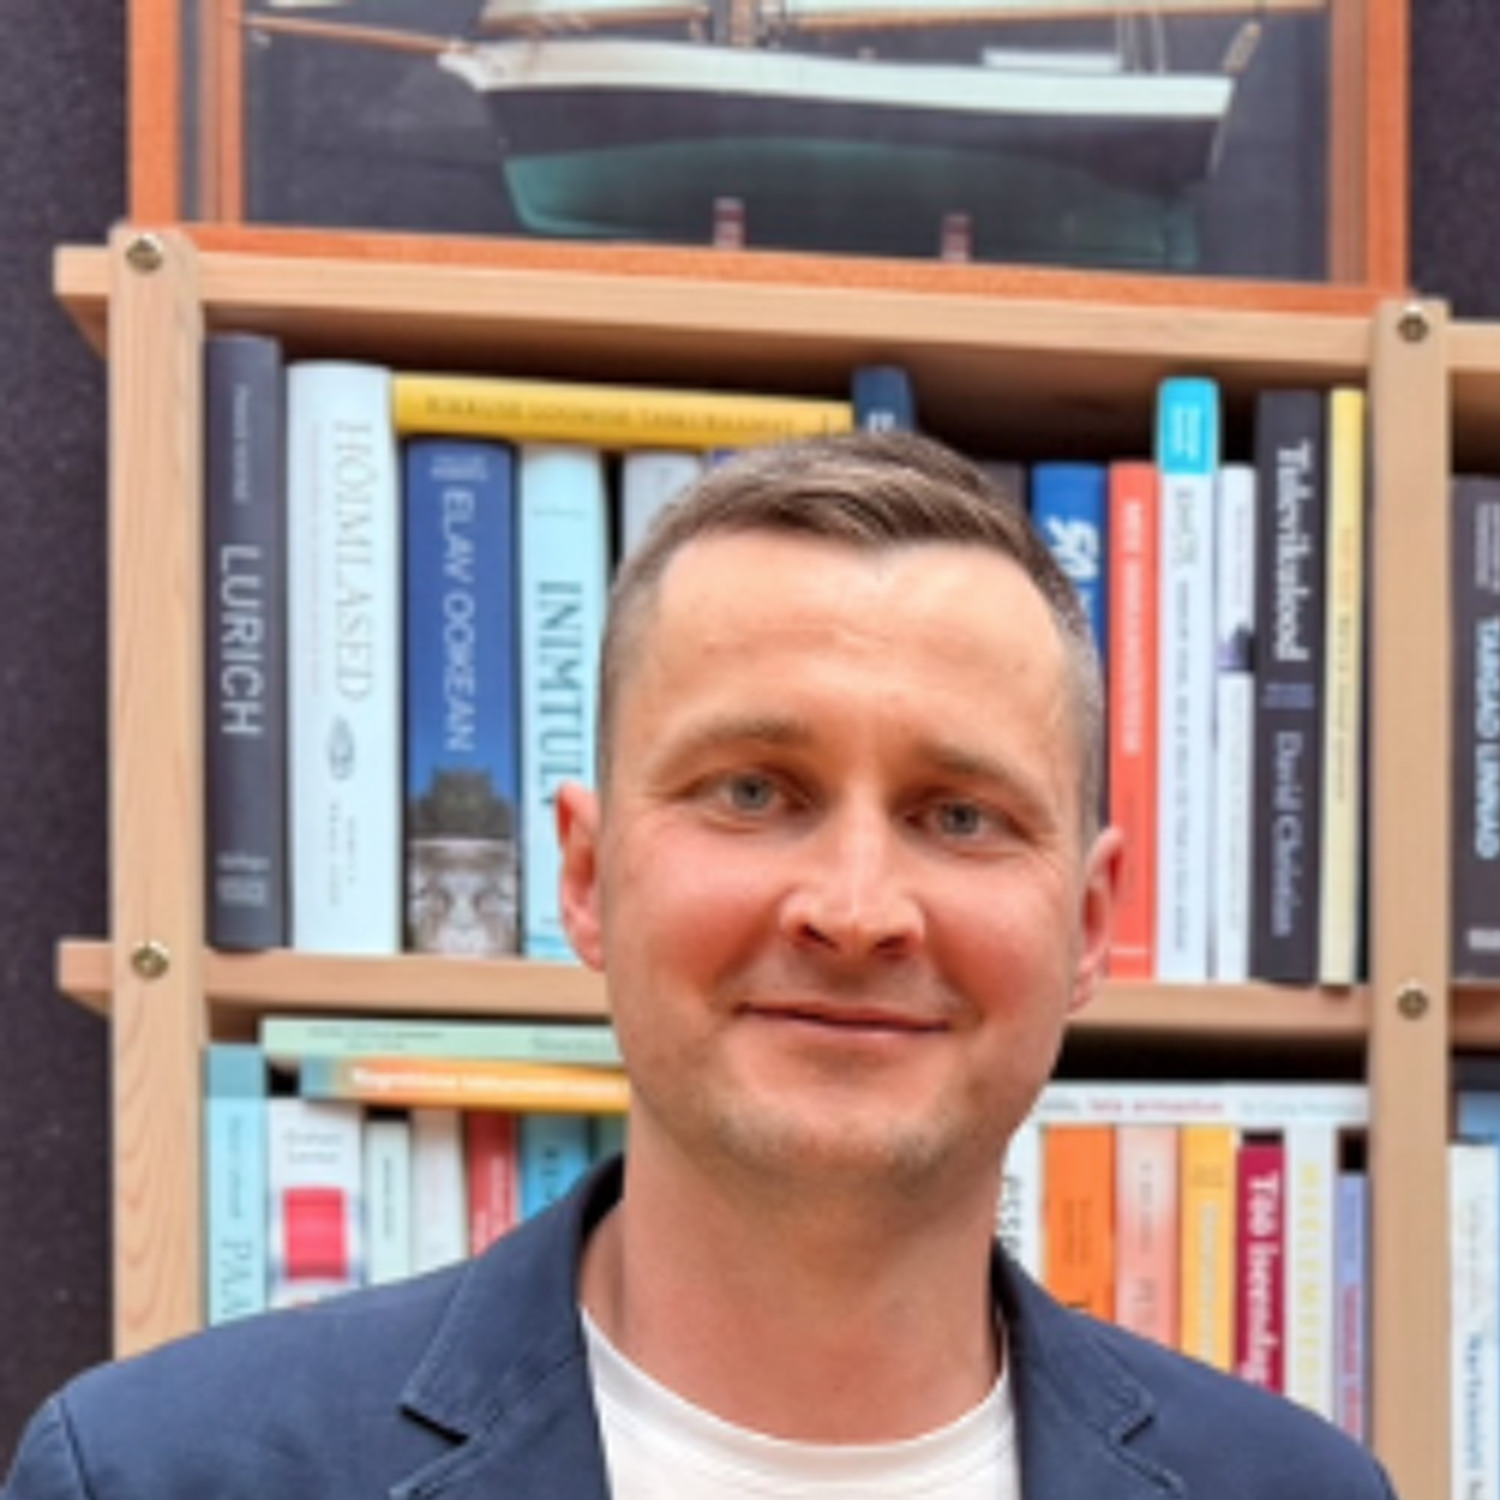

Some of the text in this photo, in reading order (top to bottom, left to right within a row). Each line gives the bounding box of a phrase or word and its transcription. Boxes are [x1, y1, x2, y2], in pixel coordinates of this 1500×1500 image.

[335, 421, 375, 702] HÕIMLASED
[444, 489, 476, 583] ELAV
[1275, 441, 1314, 663] Tulevikulood
[221, 543, 262, 735] LURICH
[444, 592, 476, 753] OOKEAN
[1274, 731, 1303, 808] David
[1271, 812, 1303, 938] Christian
[1249, 1169, 1279, 1237] Töö
